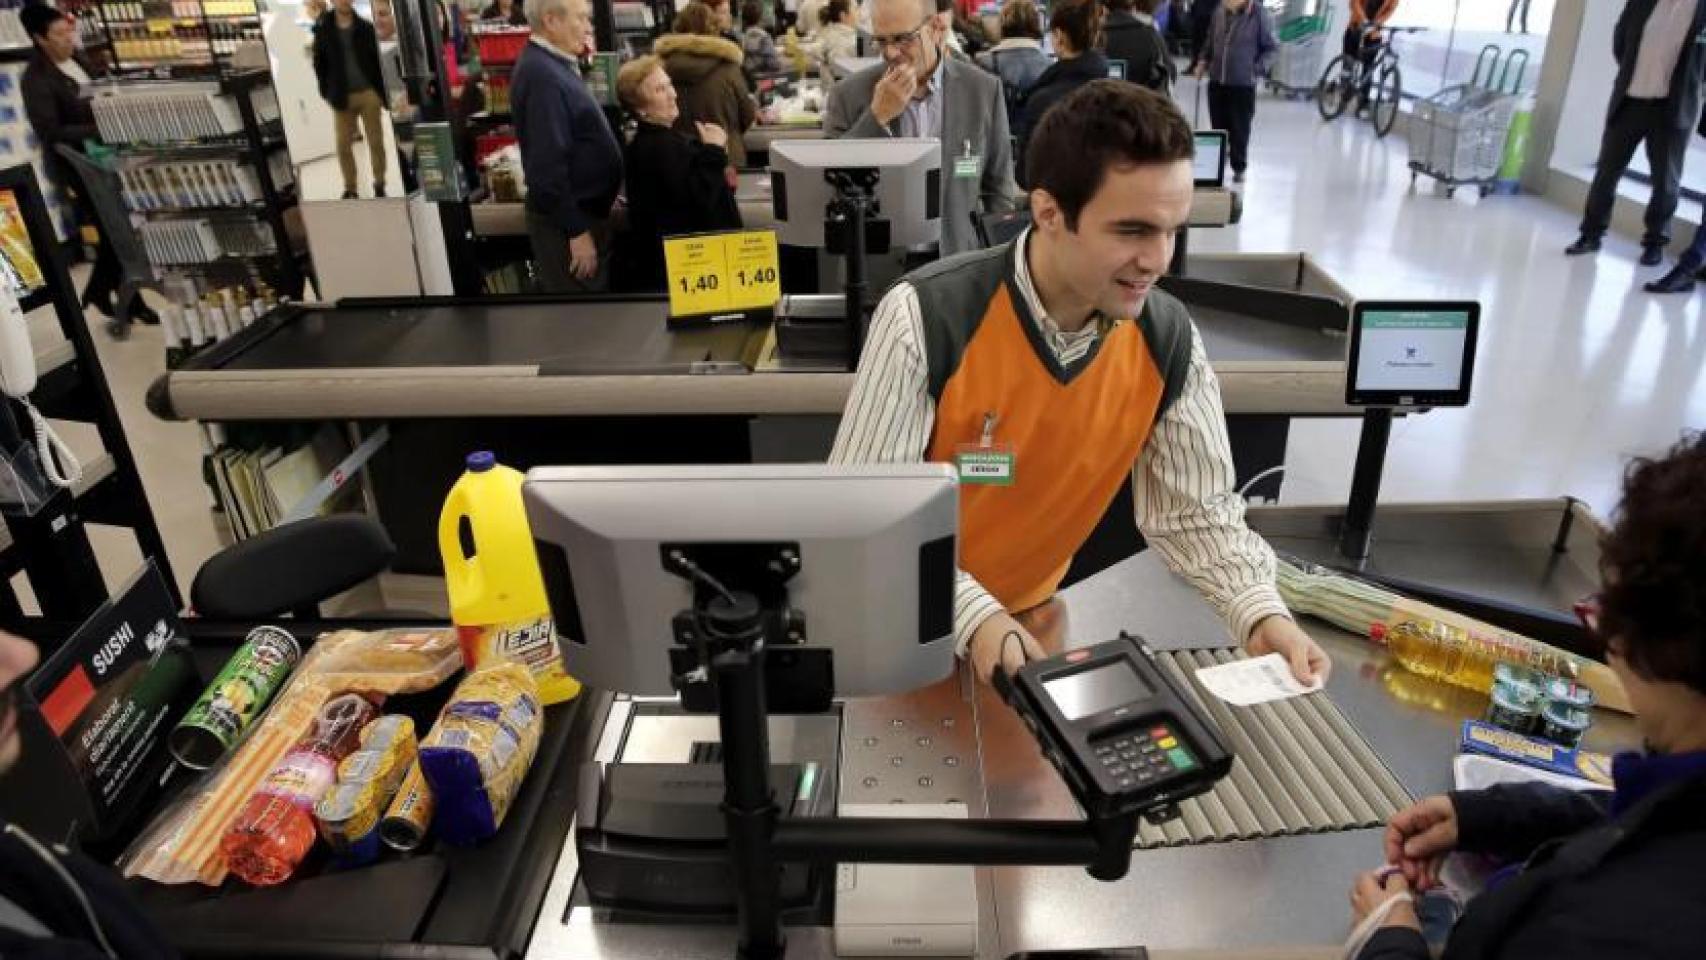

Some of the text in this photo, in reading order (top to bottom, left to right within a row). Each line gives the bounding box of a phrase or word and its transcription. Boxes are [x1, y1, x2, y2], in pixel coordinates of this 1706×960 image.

[680, 274, 719, 294] 1,40
[738, 267, 775, 286] 1,40
[92, 621, 134, 675] SUSHI
